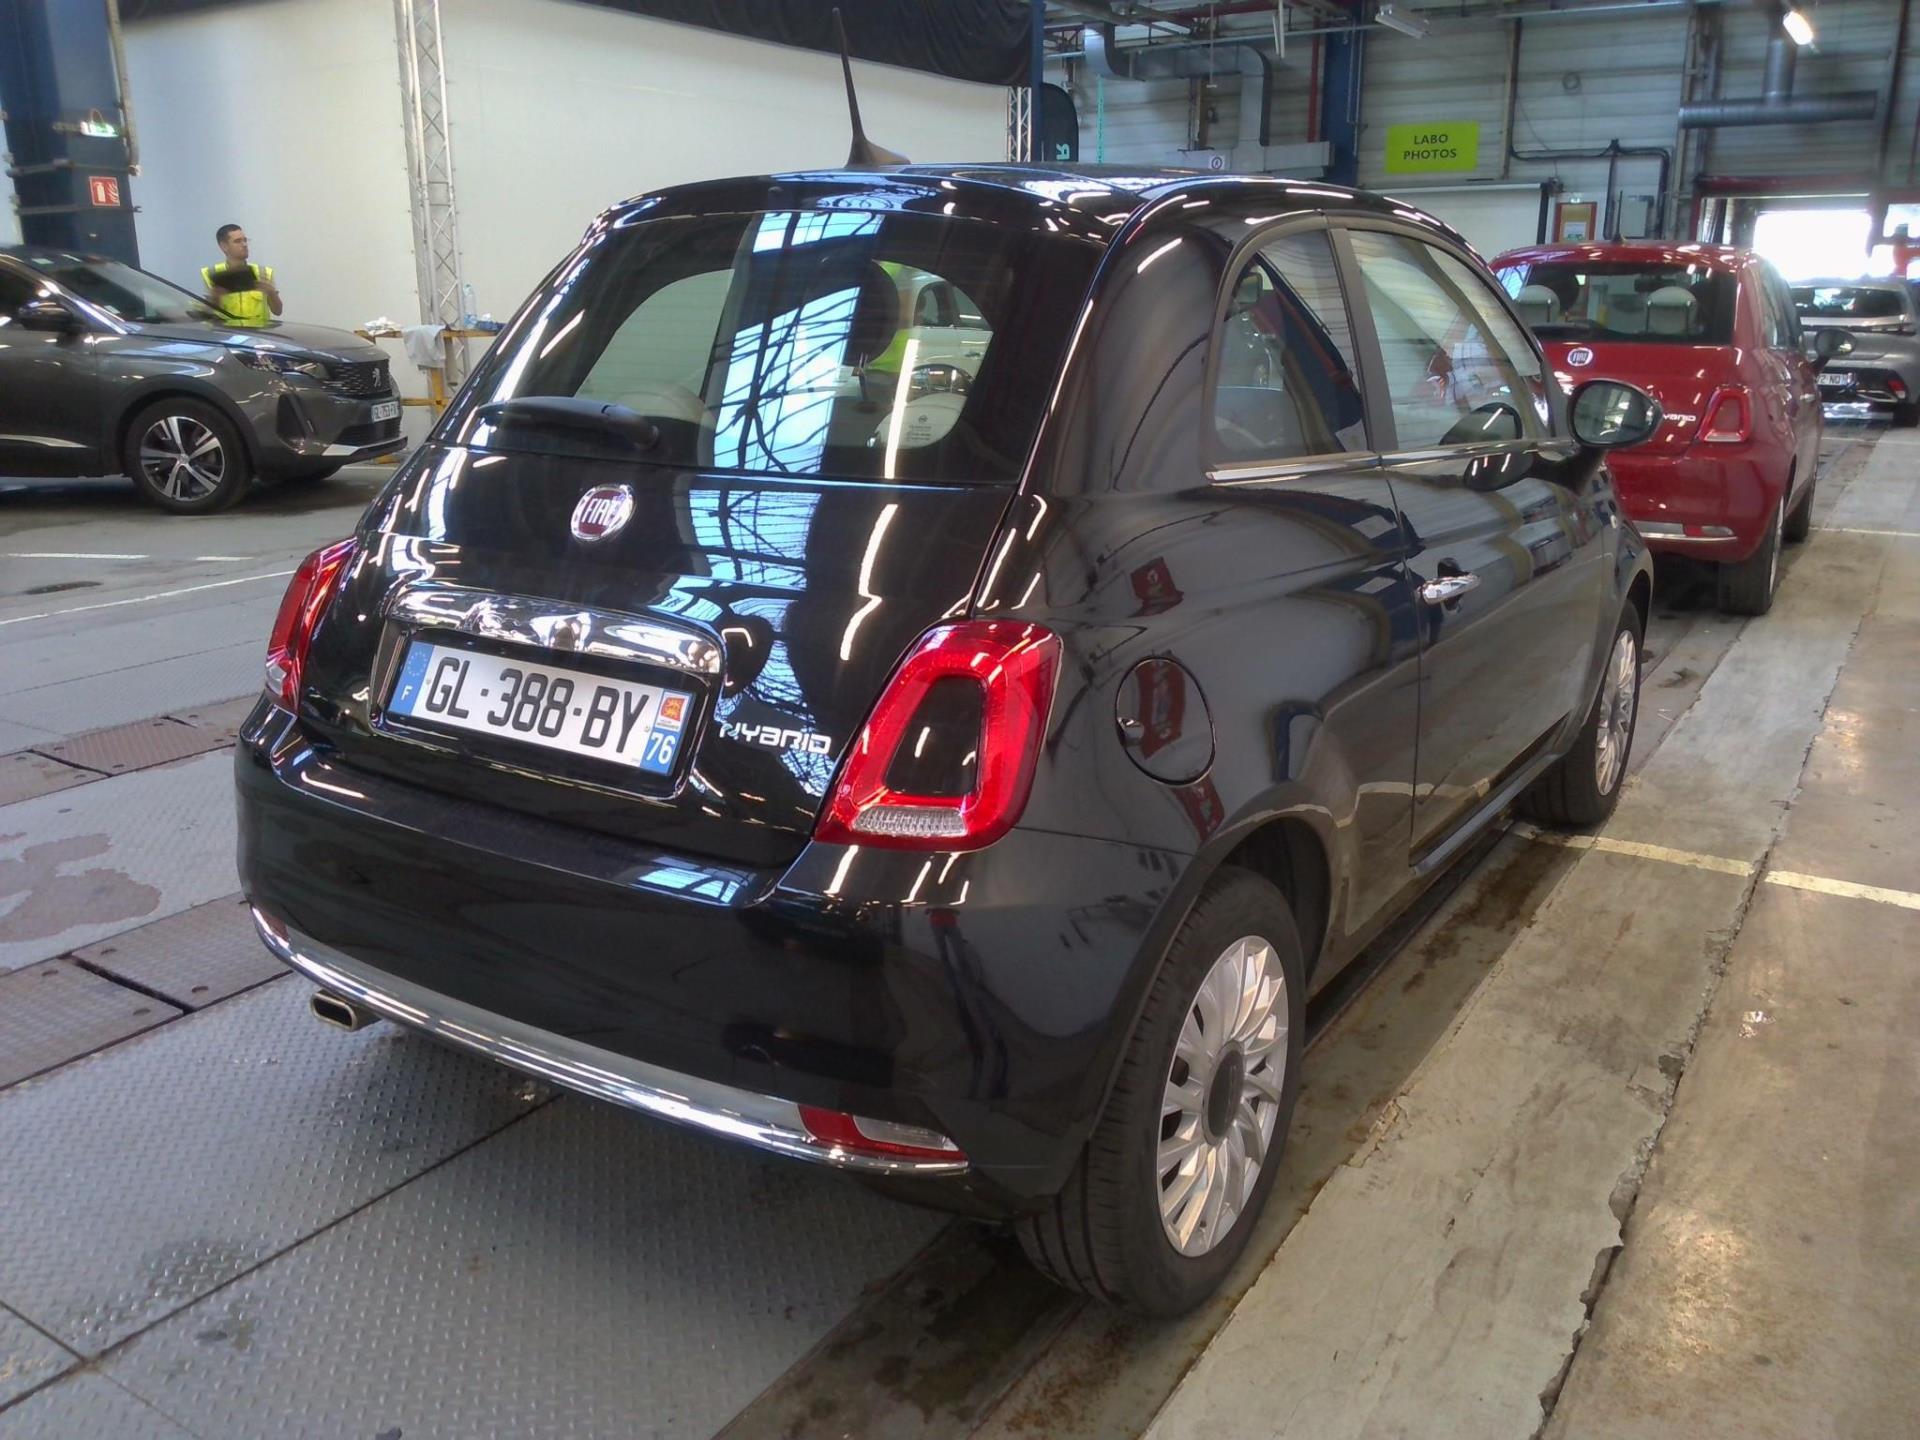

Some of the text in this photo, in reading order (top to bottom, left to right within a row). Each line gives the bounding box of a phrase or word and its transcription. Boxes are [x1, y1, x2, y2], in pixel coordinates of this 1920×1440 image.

[1413, 133, 1448, 145] LABO
[1403, 148, 1457, 160] PHOTOS
[1662, 413, 1697, 422] YBRID
[581, 496, 623, 526] FIAT
[401, 656, 676, 765] F GL-388-BY 76
